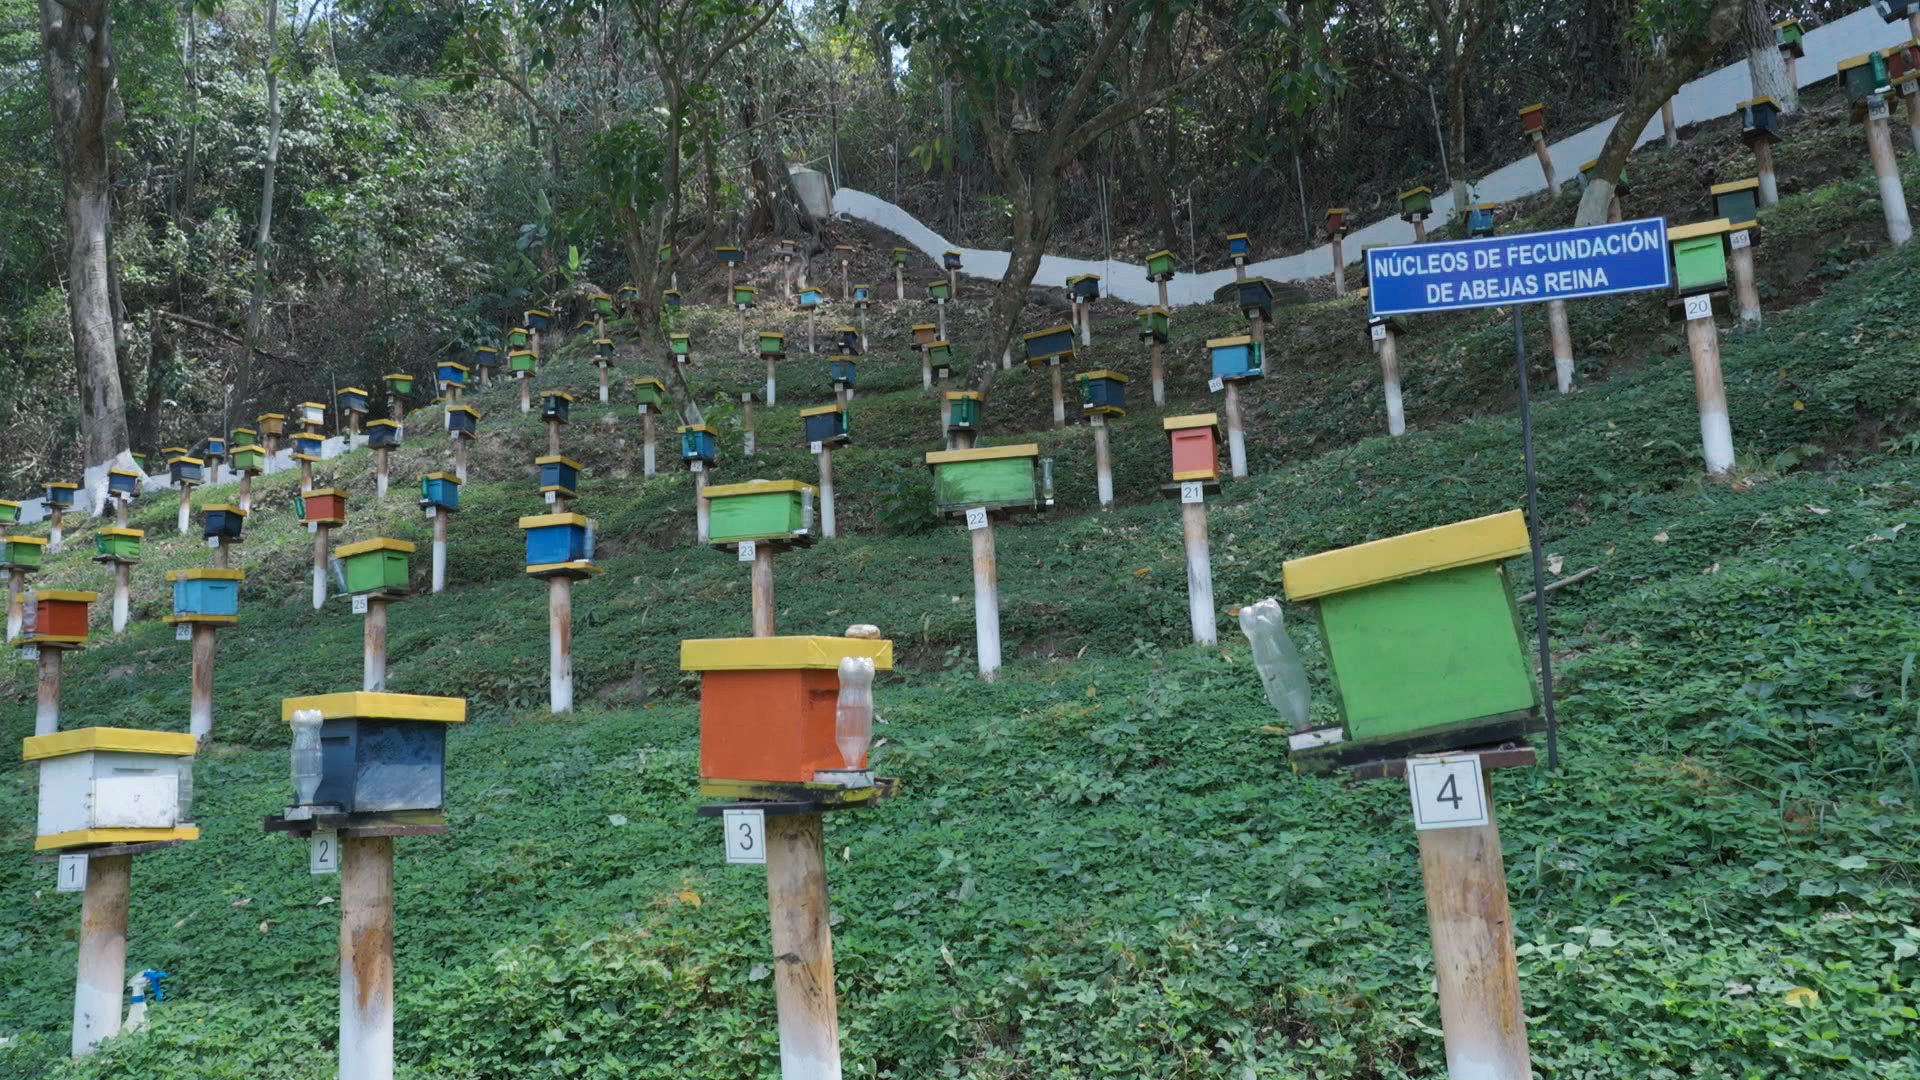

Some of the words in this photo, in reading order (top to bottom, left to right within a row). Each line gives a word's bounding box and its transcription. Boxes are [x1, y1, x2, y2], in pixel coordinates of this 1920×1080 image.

[1375, 249, 1469, 278] NÚCLEOS
[1474, 248, 1502, 270] DE
[1507, 226, 1659, 267] FECUNDACIÓN
[1426, 282, 1454, 304] DE
[1459, 274, 1539, 302] ABEJAS
[1544, 266, 1609, 294] REINA
[1688, 300, 1708, 315] 20
[1373, 327, 1385, 337] 47
[1184, 487, 1198, 498] 21
[969, 512, 985, 525] 22
[741, 545, 754, 557] 23
[354, 600, 365, 610] 25
[177, 625, 190, 636] 26
[1437, 773, 1463, 810] 4
[738, 823, 754, 851] 3
[319, 839, 329, 863] 2
[68, 863, 76, 883] 1
